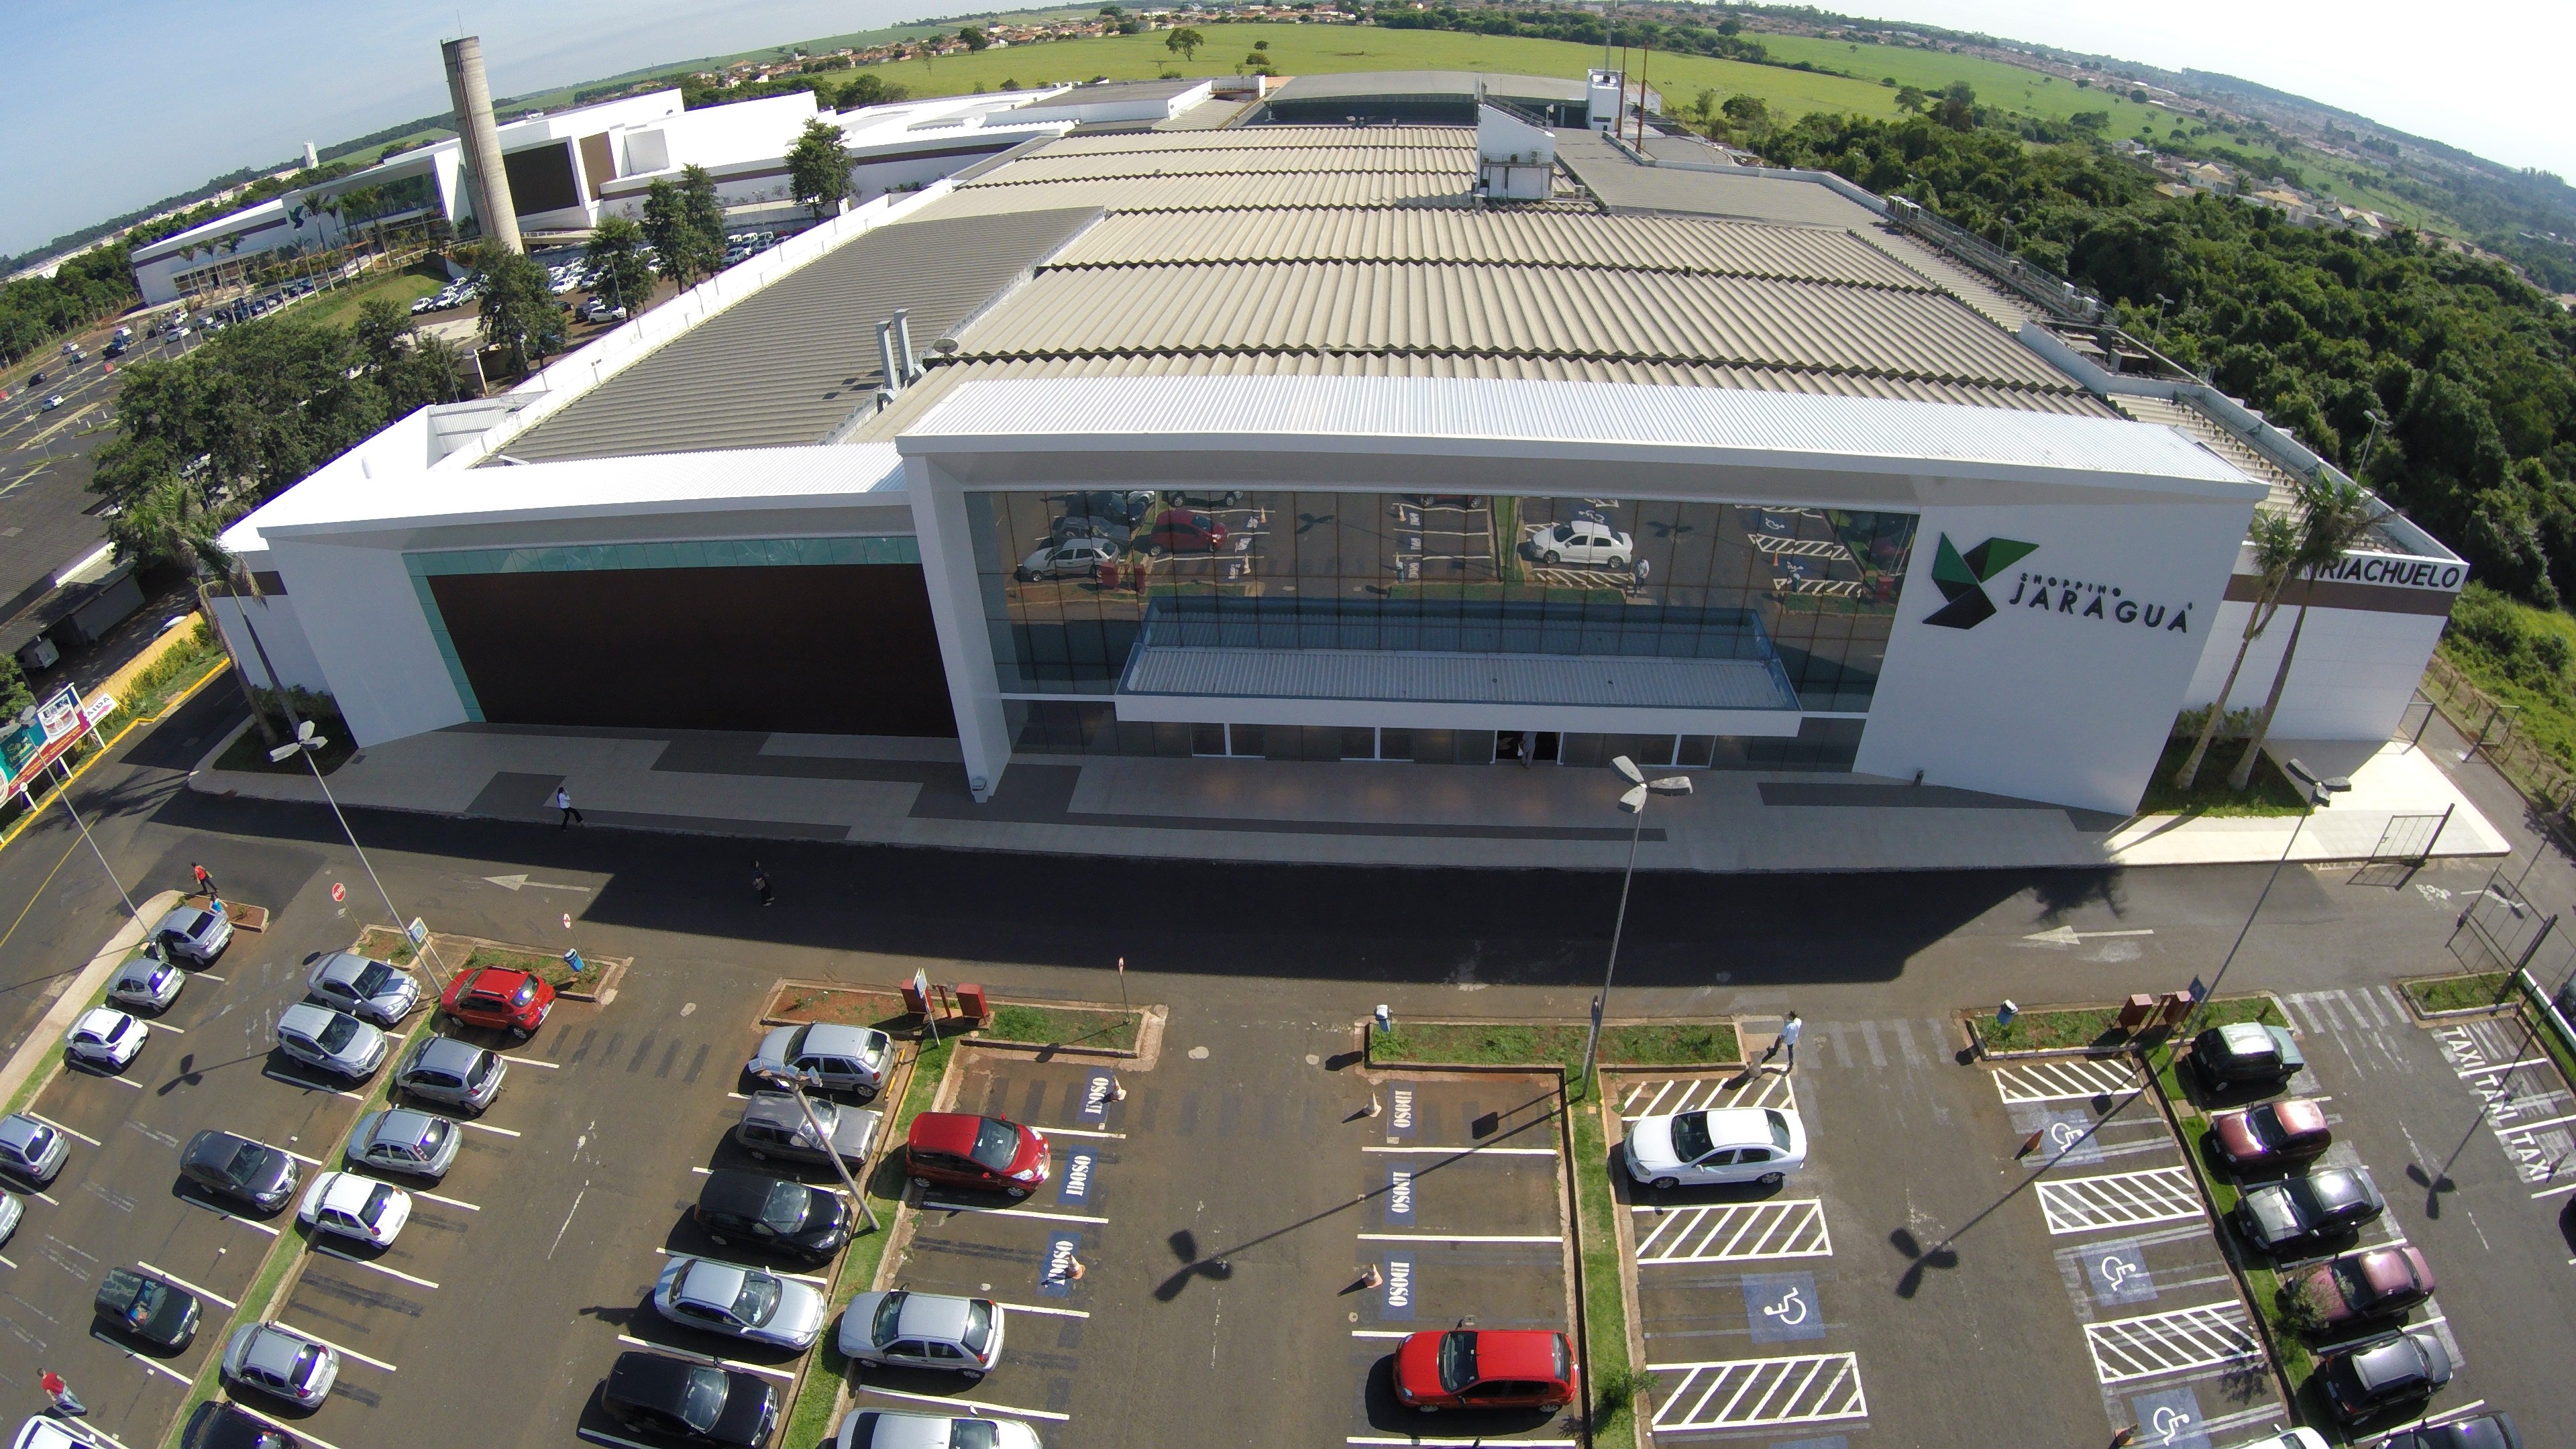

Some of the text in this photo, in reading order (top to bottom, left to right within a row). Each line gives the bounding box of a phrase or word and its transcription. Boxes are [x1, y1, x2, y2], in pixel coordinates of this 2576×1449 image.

[2319, 557, 2460, 588] RIACHUELO
[2008, 582, 2193, 634] JARAGUÁ
[2442, 1026, 2486, 1068] TAXI
[1085, 1077, 1109, 1115] IDOSO
[1393, 1090, 1412, 1128] IDOSO
[2475, 1074, 2518, 1120] TAXI
[1065, 1155, 1091, 1197] IDOSO
[2511, 1132, 2551, 1181] TAXI
[1391, 1171, 1411, 1214] IDOSO
[1388, 1261, 1410, 1307] IDOSO
